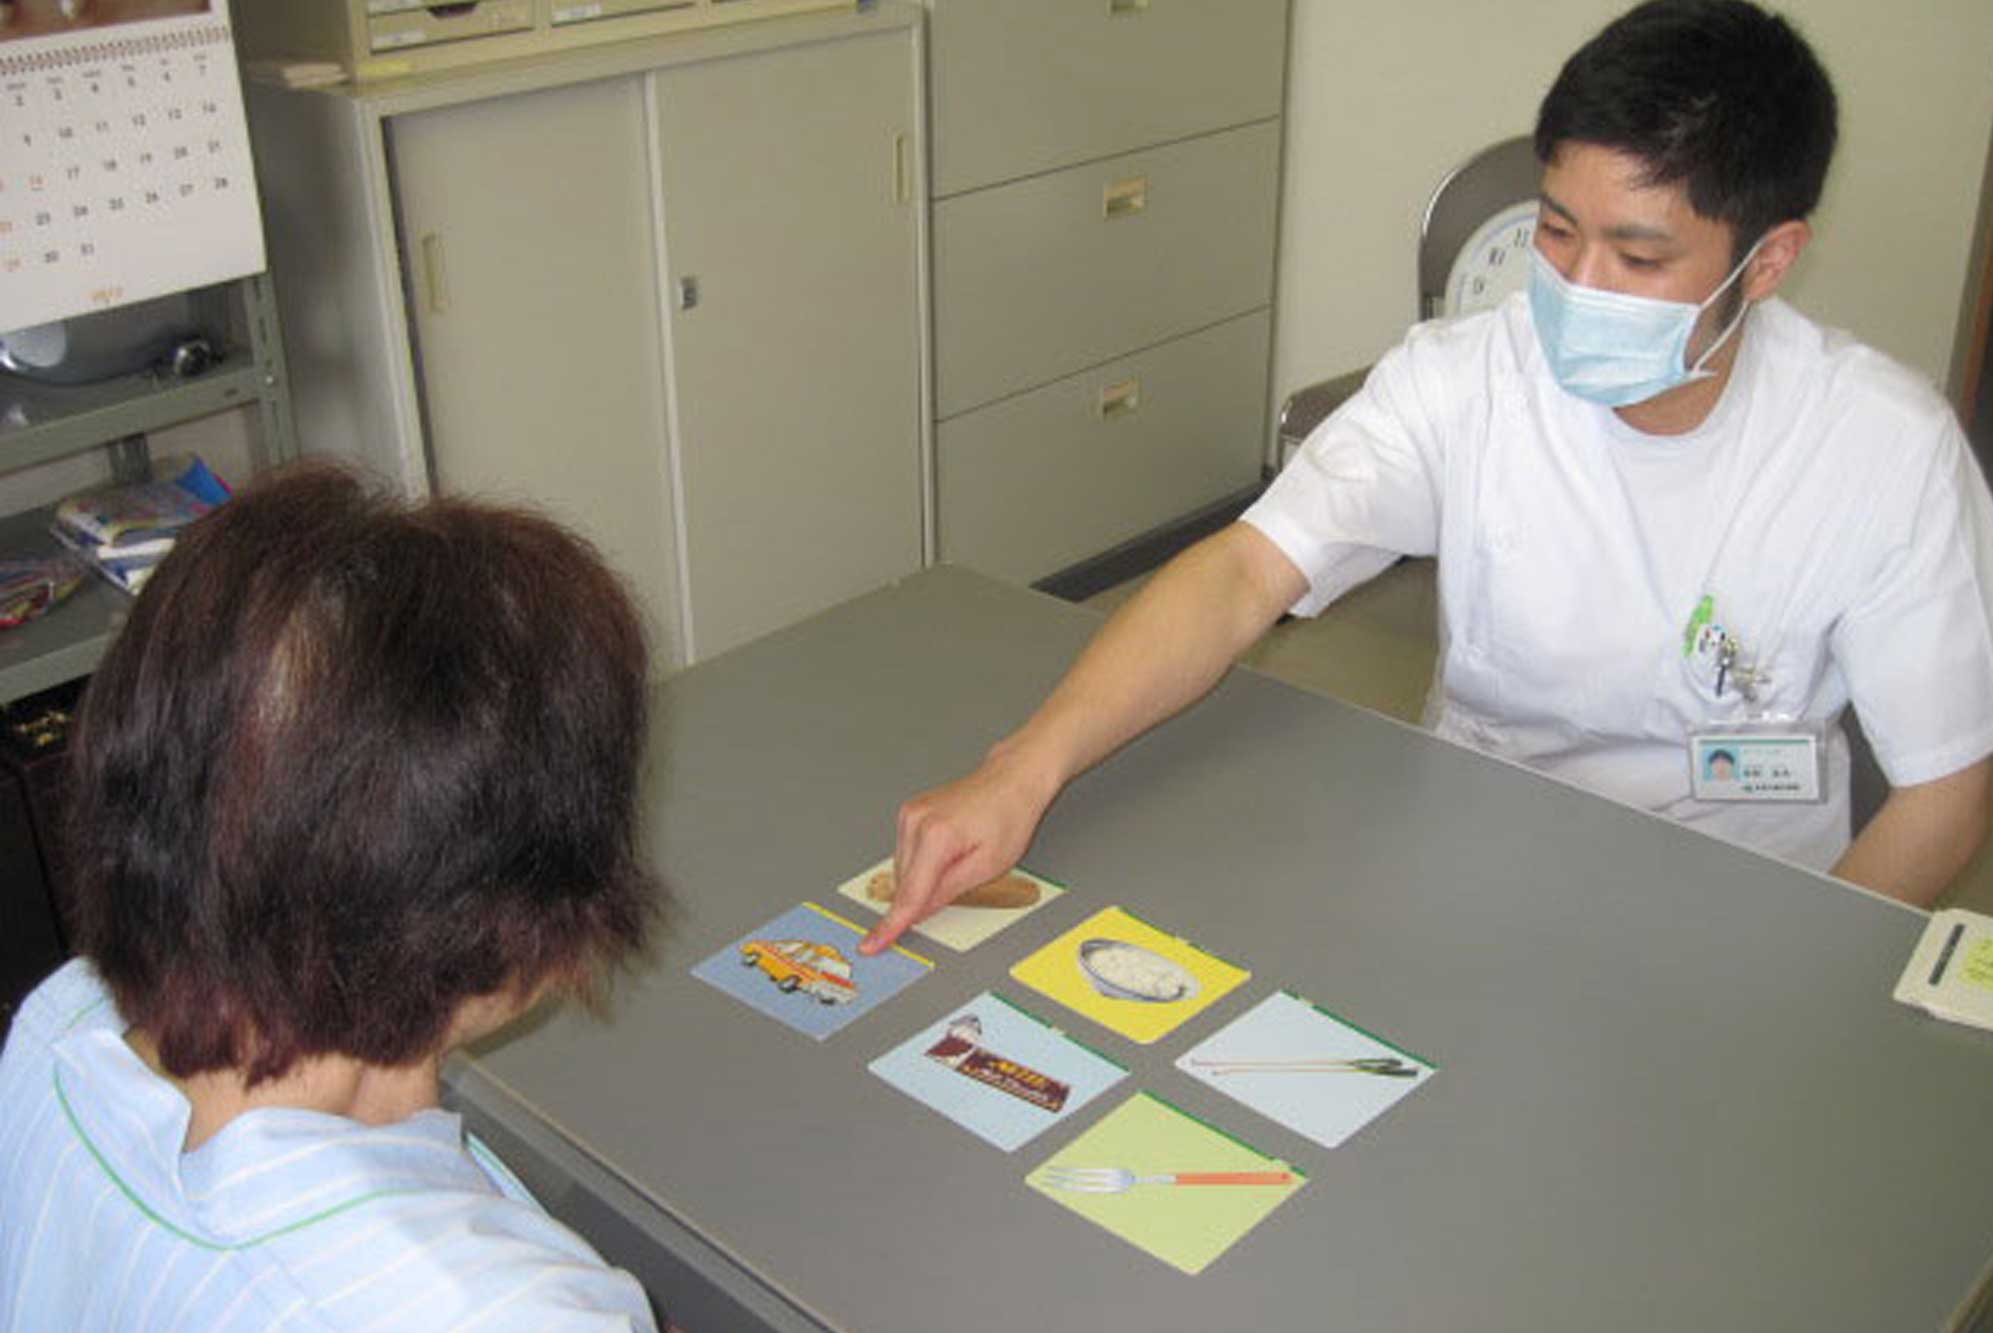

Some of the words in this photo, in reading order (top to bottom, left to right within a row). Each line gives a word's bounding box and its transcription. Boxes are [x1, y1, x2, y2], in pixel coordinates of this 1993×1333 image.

[58, 126, 74, 139] 10
[95, 120, 110, 132] 11
[131, 113, 147, 126] 12
[167, 107, 183, 120] 13
[66, 165, 81, 180] 17
[179, 183, 194, 197] 27
[214, 177, 229, 190] 28
